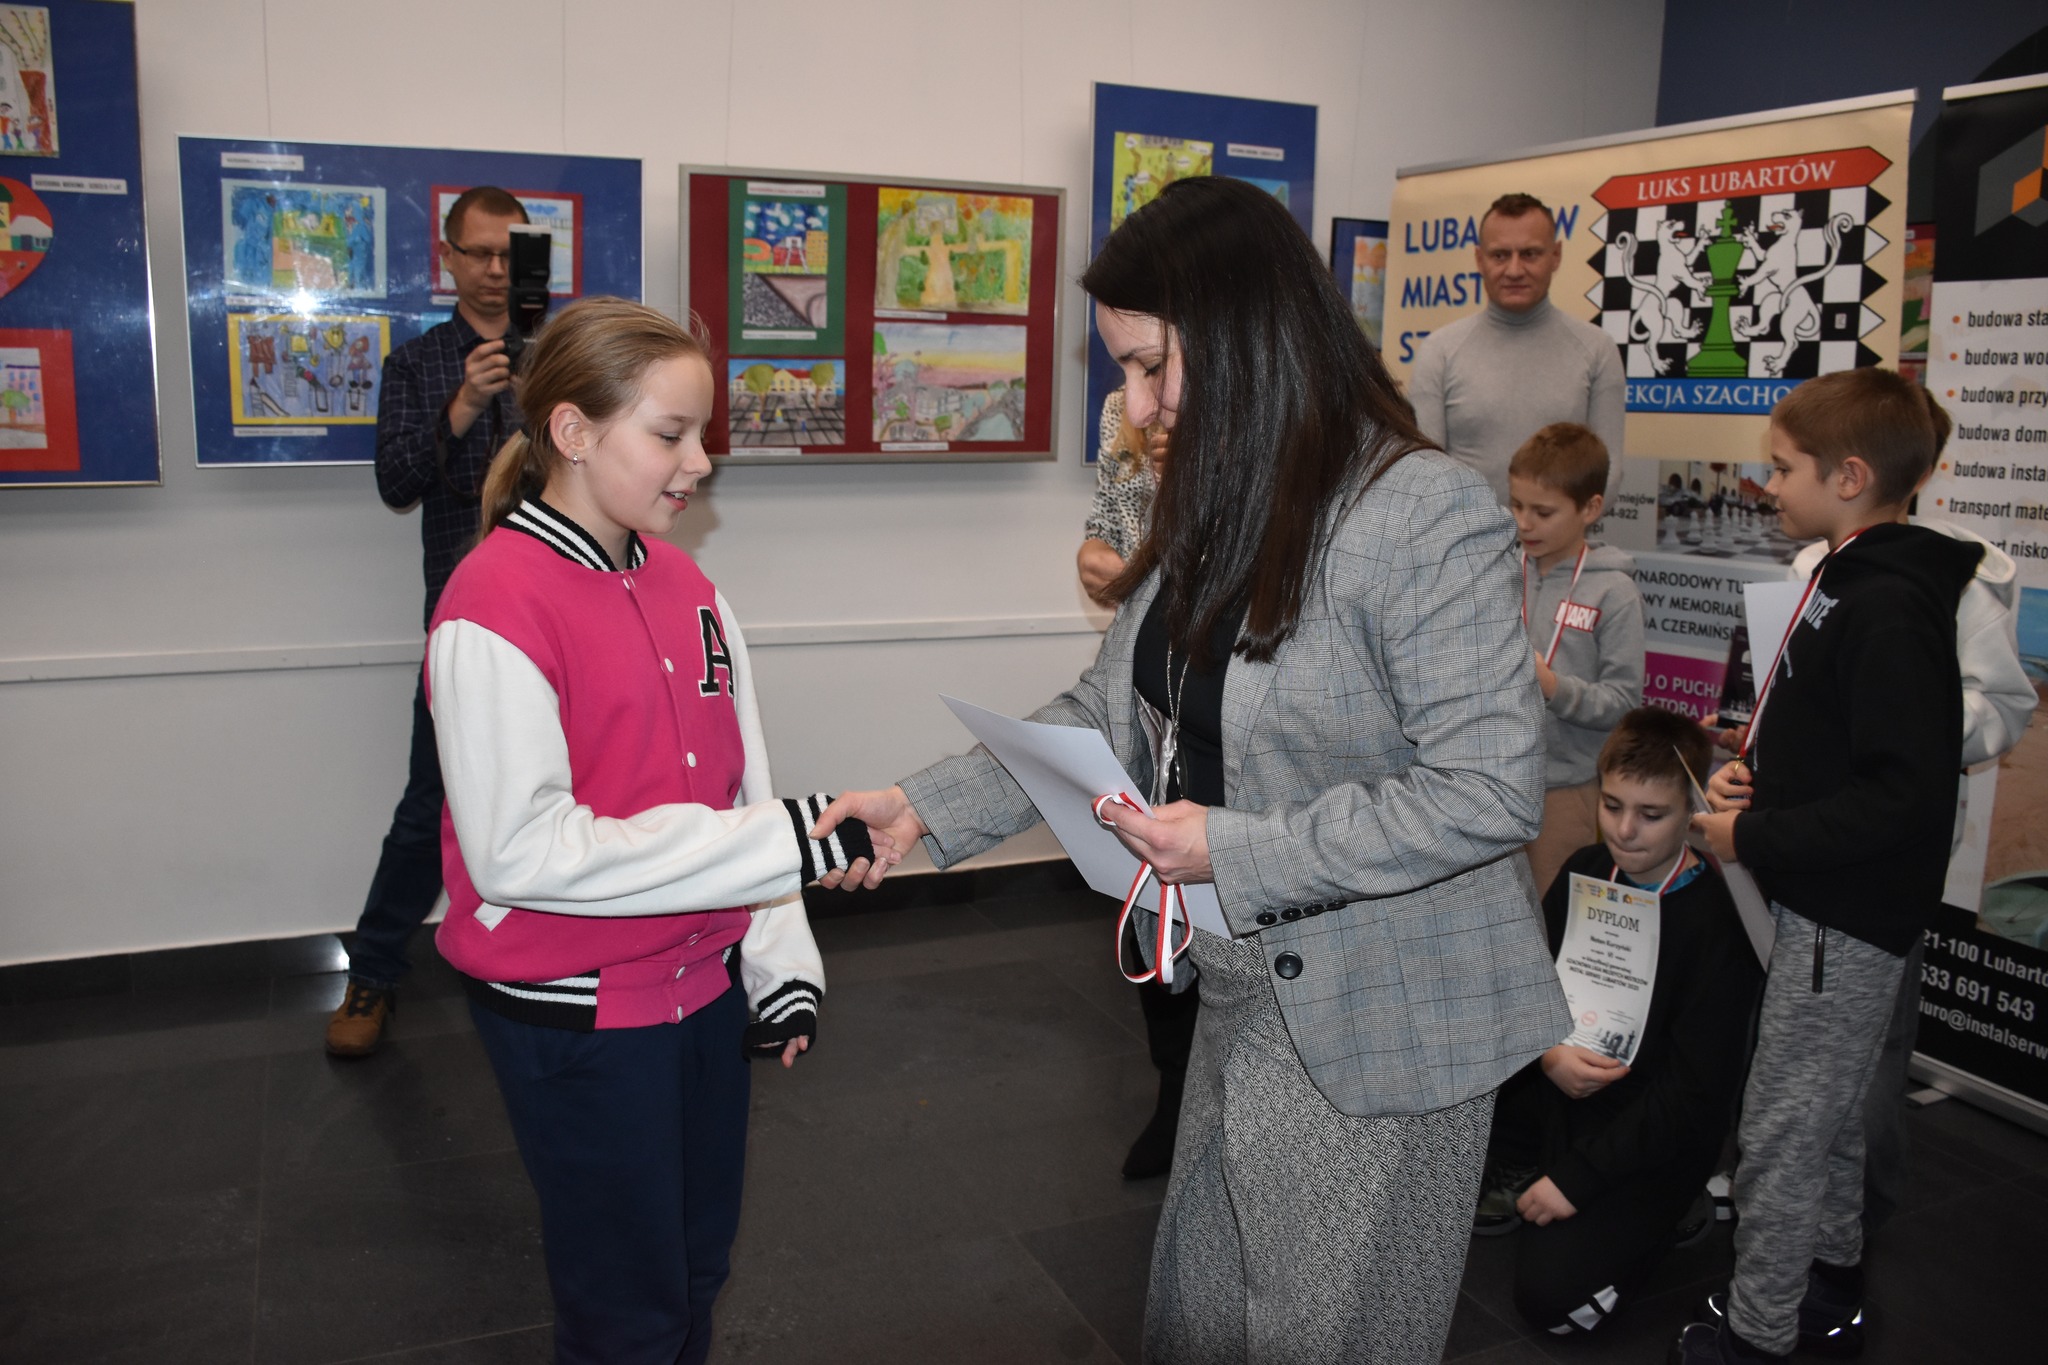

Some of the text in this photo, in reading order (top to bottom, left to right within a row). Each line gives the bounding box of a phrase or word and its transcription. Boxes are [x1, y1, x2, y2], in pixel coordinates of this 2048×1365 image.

[1637, 158, 1836, 201] LUKS LUBARTÓW
[1405, 204, 1580, 254] LUBAW
[1968, 310, 2048, 328] budowa sta
[1964, 348, 2018, 366] budowa
[1961, 386, 2048, 408] budowa przy
[1958, 423, 2009, 442] budowa
[1953, 460, 2048, 482] budowa insta
[1949, 497, 2010, 519] transport
[2011, 540, 2048, 560] nisko
[1669, 597, 1743, 619] MEMORIAŁ
[1661, 618, 1735, 641] CZERMIŃS
[697, 606, 734, 698] A
[1655, 674, 1668, 691] O
[1587, 906, 1640, 932] DYPLOM
[1955, 975, 1990, 1006] 691
[1996, 990, 2035, 1022] 543
